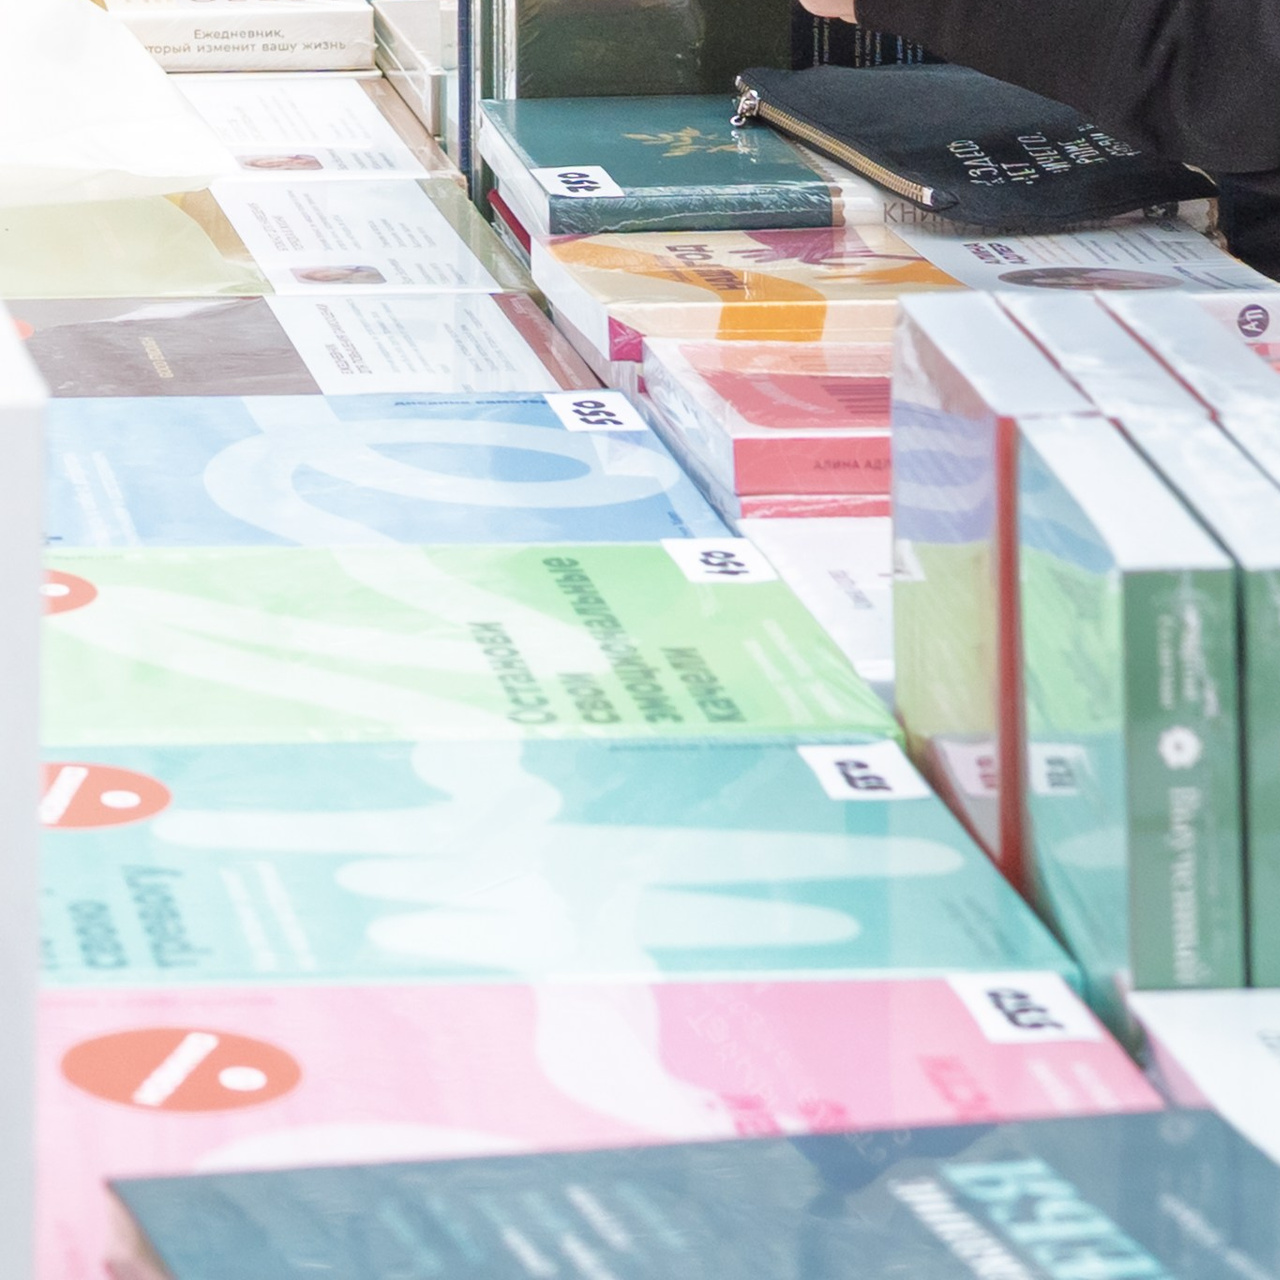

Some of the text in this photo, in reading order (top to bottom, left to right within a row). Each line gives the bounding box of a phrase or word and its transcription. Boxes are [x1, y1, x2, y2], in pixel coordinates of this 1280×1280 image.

[194, 28, 285, 41] Ежедневник,
[146, 41, 348, 56] торый изменит вашу жизнь
[1057, 139, 1109, 167] РОМЕ
